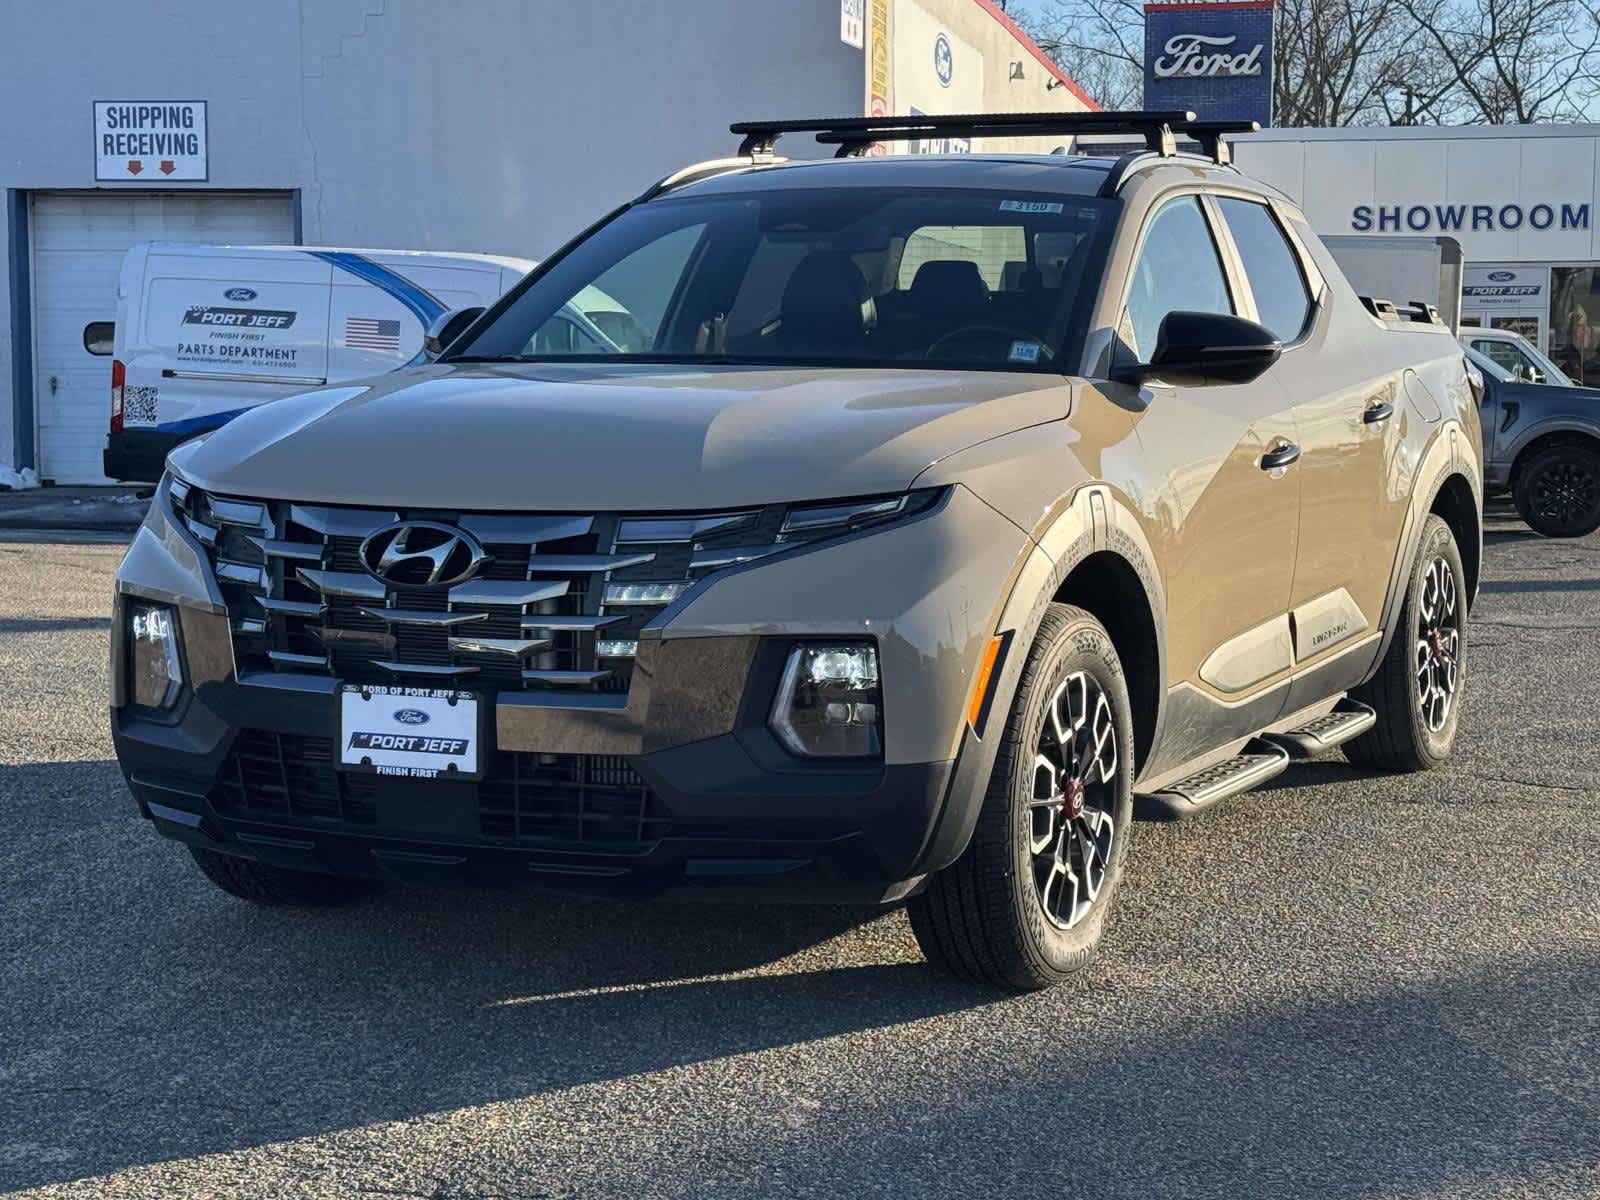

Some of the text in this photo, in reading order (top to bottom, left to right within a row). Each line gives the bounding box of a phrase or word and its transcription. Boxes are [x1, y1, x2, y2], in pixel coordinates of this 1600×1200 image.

[1154, 34, 1264, 76] Ford
[107, 106, 193, 128] SHIPPING
[103, 133, 199, 155] RECEIVING
[1351, 204, 1590, 231] SHOWROOM
[1471, 287, 1537, 295] PORT JEFF
[201, 312, 289, 327] PORT JEFF
[209, 332, 266, 341] FINISH FIRST
[177, 344, 297, 360] PARTS DEPARTMENT
[362, 685, 388, 694] FORD
[390, 686, 403, 695] OF
[405, 687, 431, 697] PORT
[432, 689, 454, 698] JEFF
[400, 710, 423, 722] Ford
[369, 736, 417, 750] PORT
[420, 740, 462, 753] JEFF
[376, 766, 438, 778] FINISH FIRST
